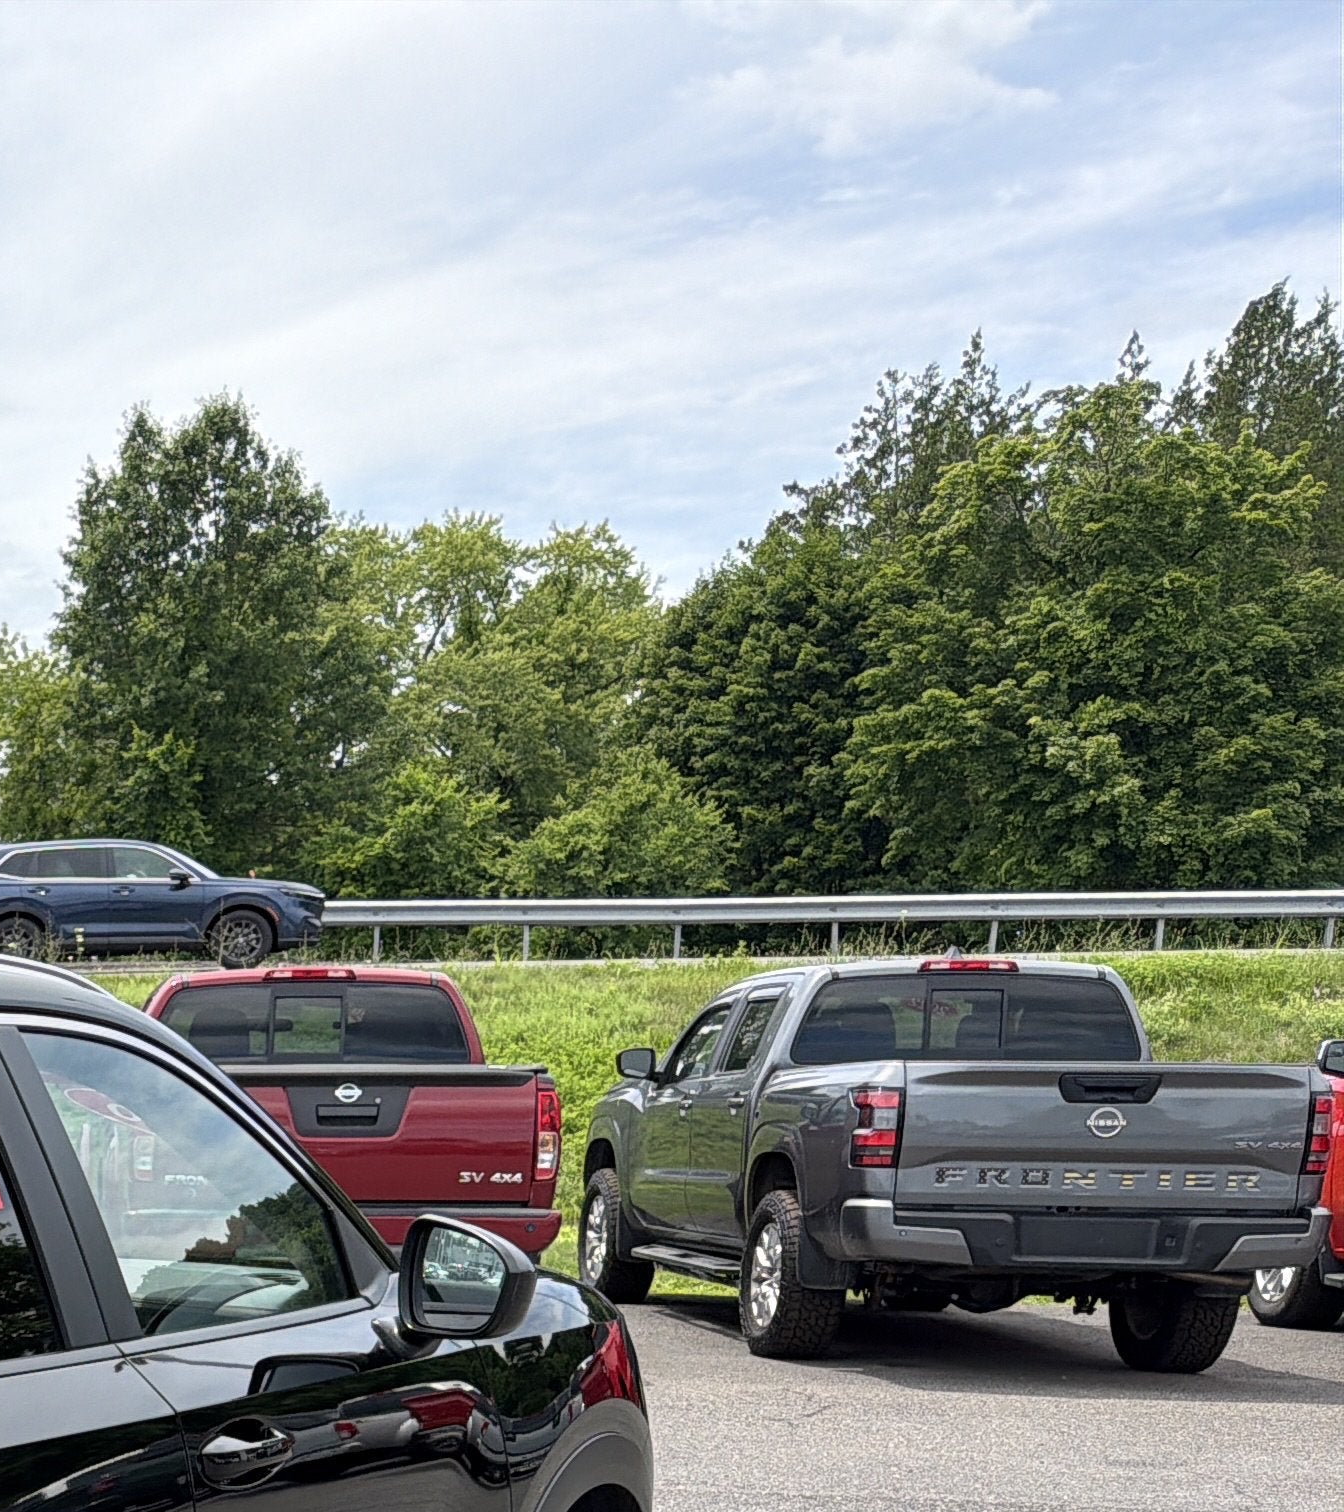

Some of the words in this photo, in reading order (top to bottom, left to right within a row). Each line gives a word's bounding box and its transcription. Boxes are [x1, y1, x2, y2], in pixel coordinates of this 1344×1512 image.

[1234, 1141, 1262, 1149] SV
[459, 1172, 484, 1183] SV
[490, 1172, 523, 1184] 4x4
[933, 1167, 1262, 1191] FRONTIER
